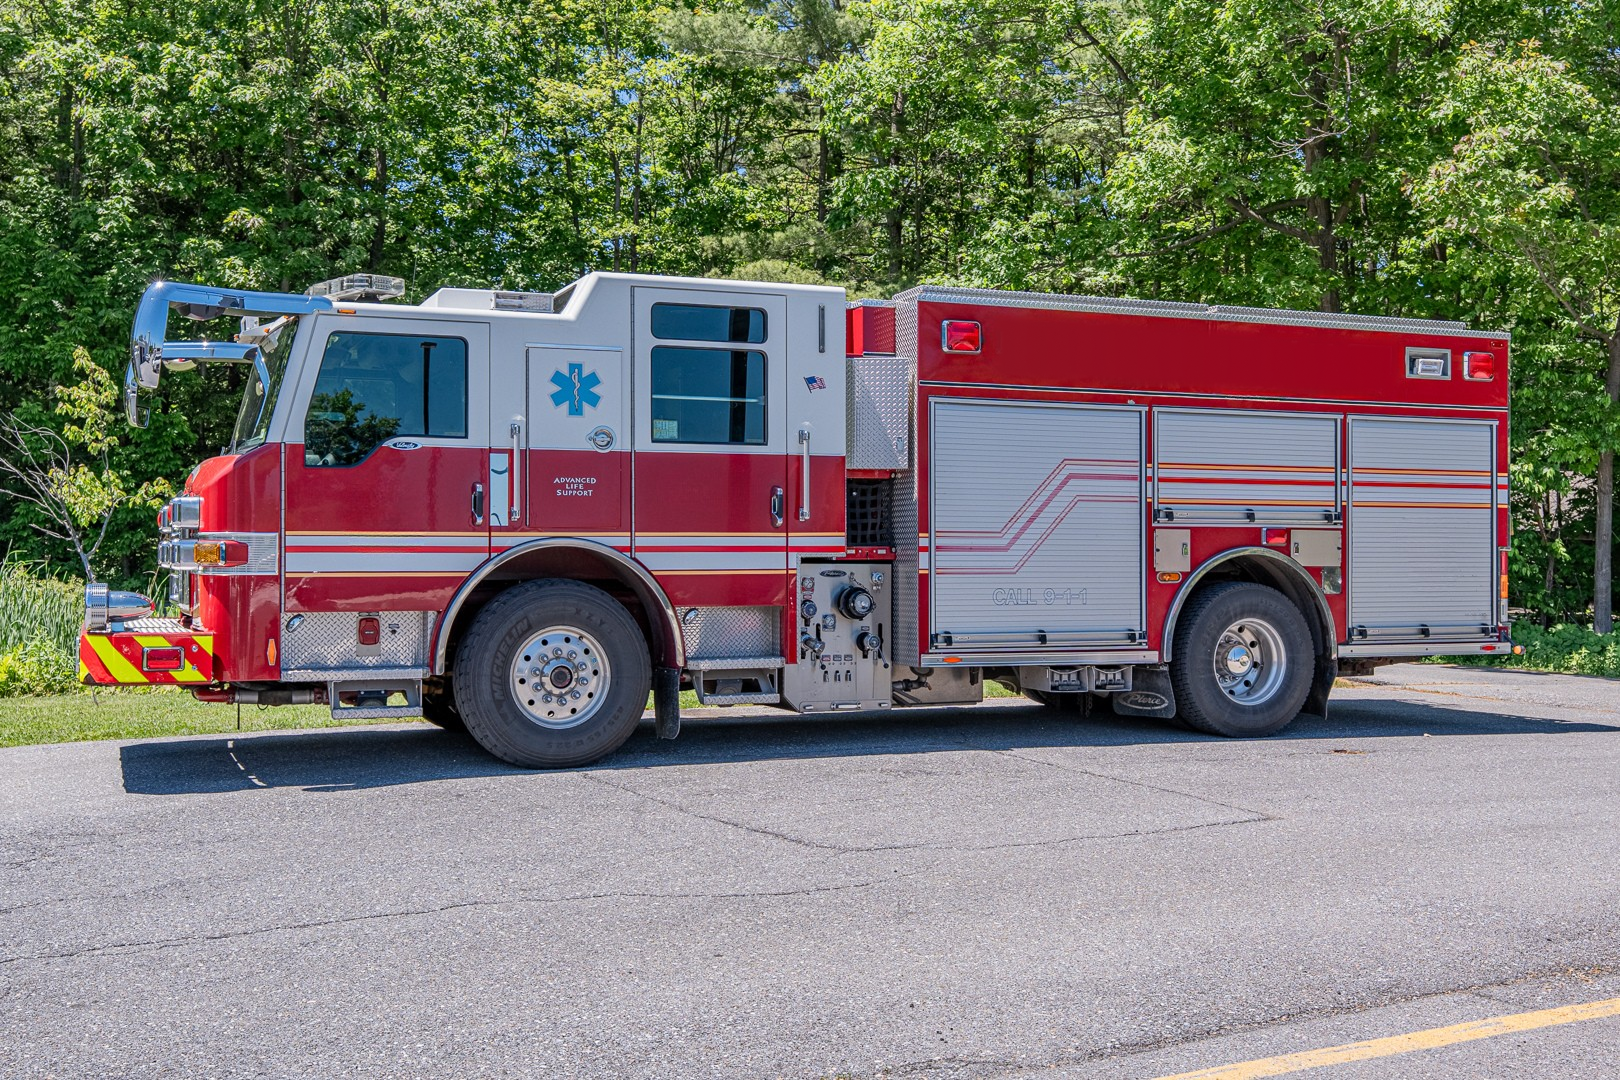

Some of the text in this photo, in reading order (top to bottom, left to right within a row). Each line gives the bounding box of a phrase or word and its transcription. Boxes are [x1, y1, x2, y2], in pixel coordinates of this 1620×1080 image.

[556, 489, 593, 497] SUPPORT
[992, 587, 1088, 606] CALL 9-1-1
[491, 617, 529, 700] MICHELIN
